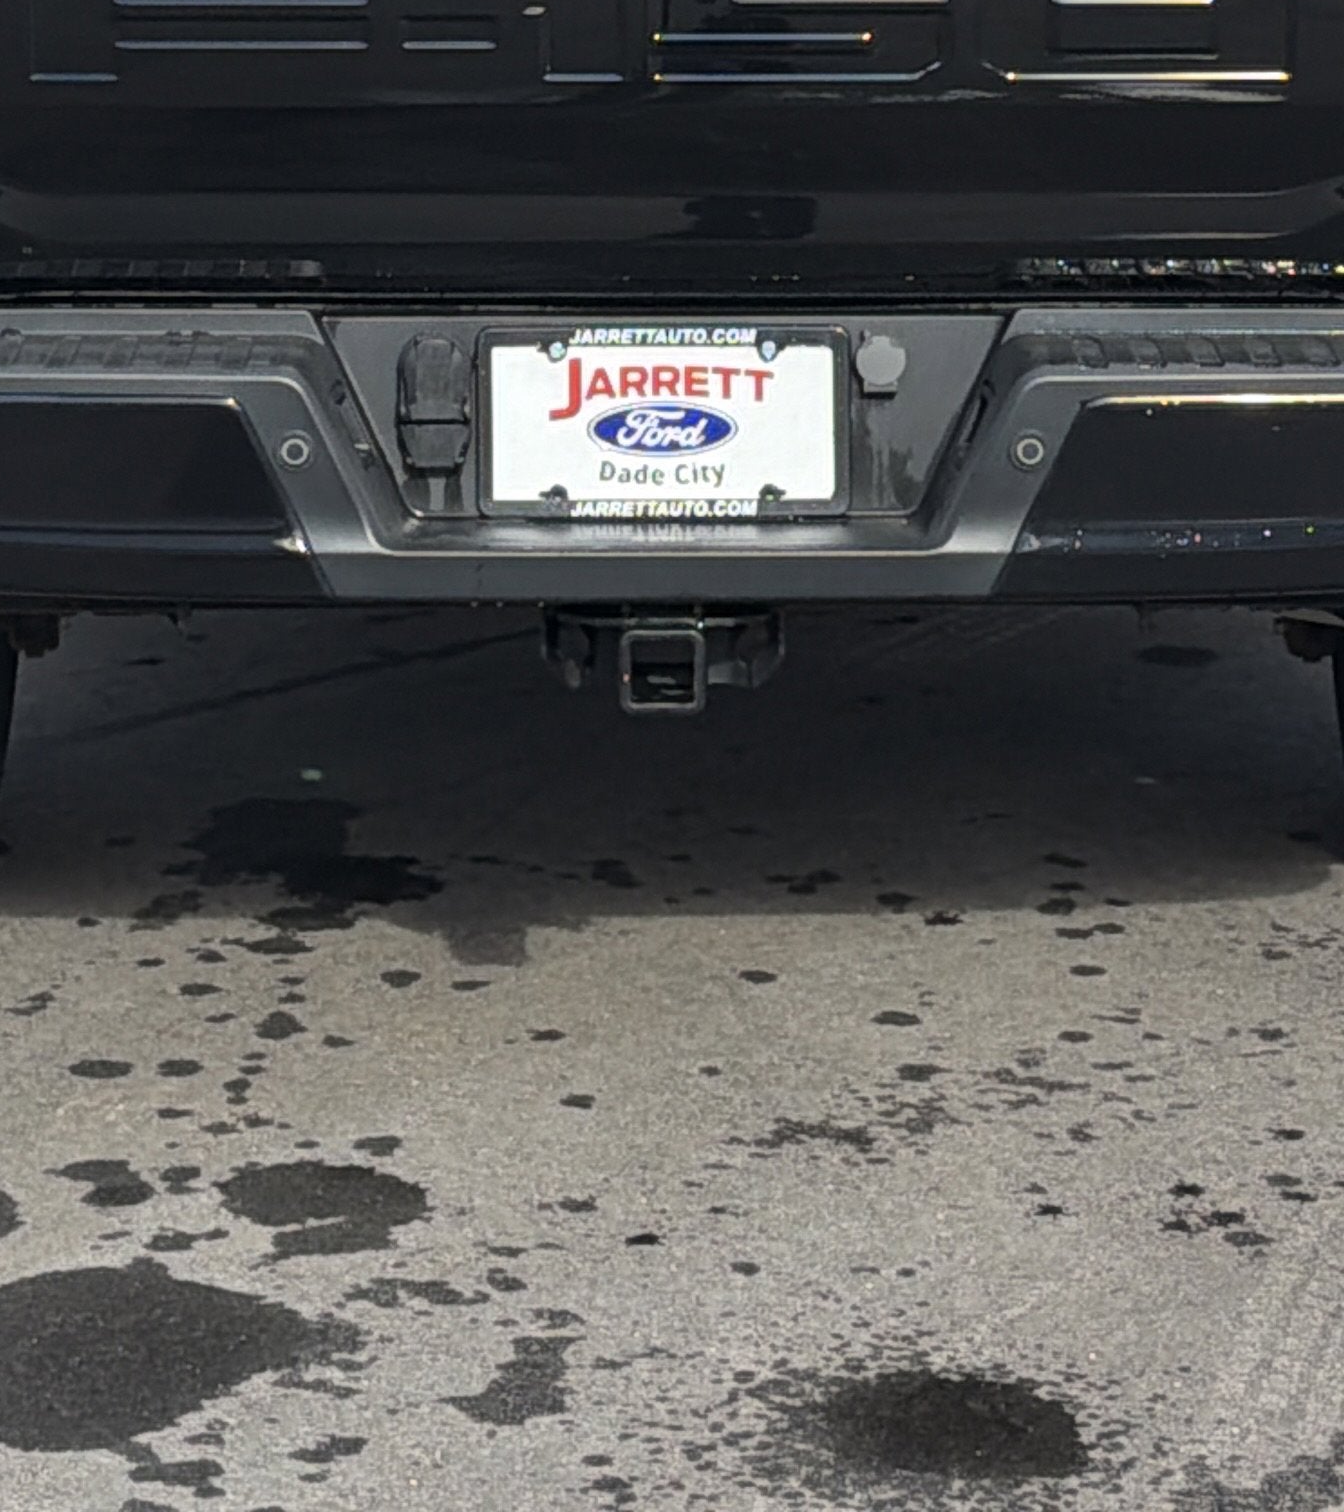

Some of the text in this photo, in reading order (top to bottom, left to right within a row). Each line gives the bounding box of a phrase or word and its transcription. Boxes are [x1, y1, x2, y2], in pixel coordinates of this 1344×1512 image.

[569, 328, 757, 345] JARRETTAUTO.COM
[549, 358, 774, 421] JARRETT
[616, 409, 708, 448] Ford
[599, 461, 726, 488] Dade City
[570, 500, 757, 518] JARRETTAUTO.COM
